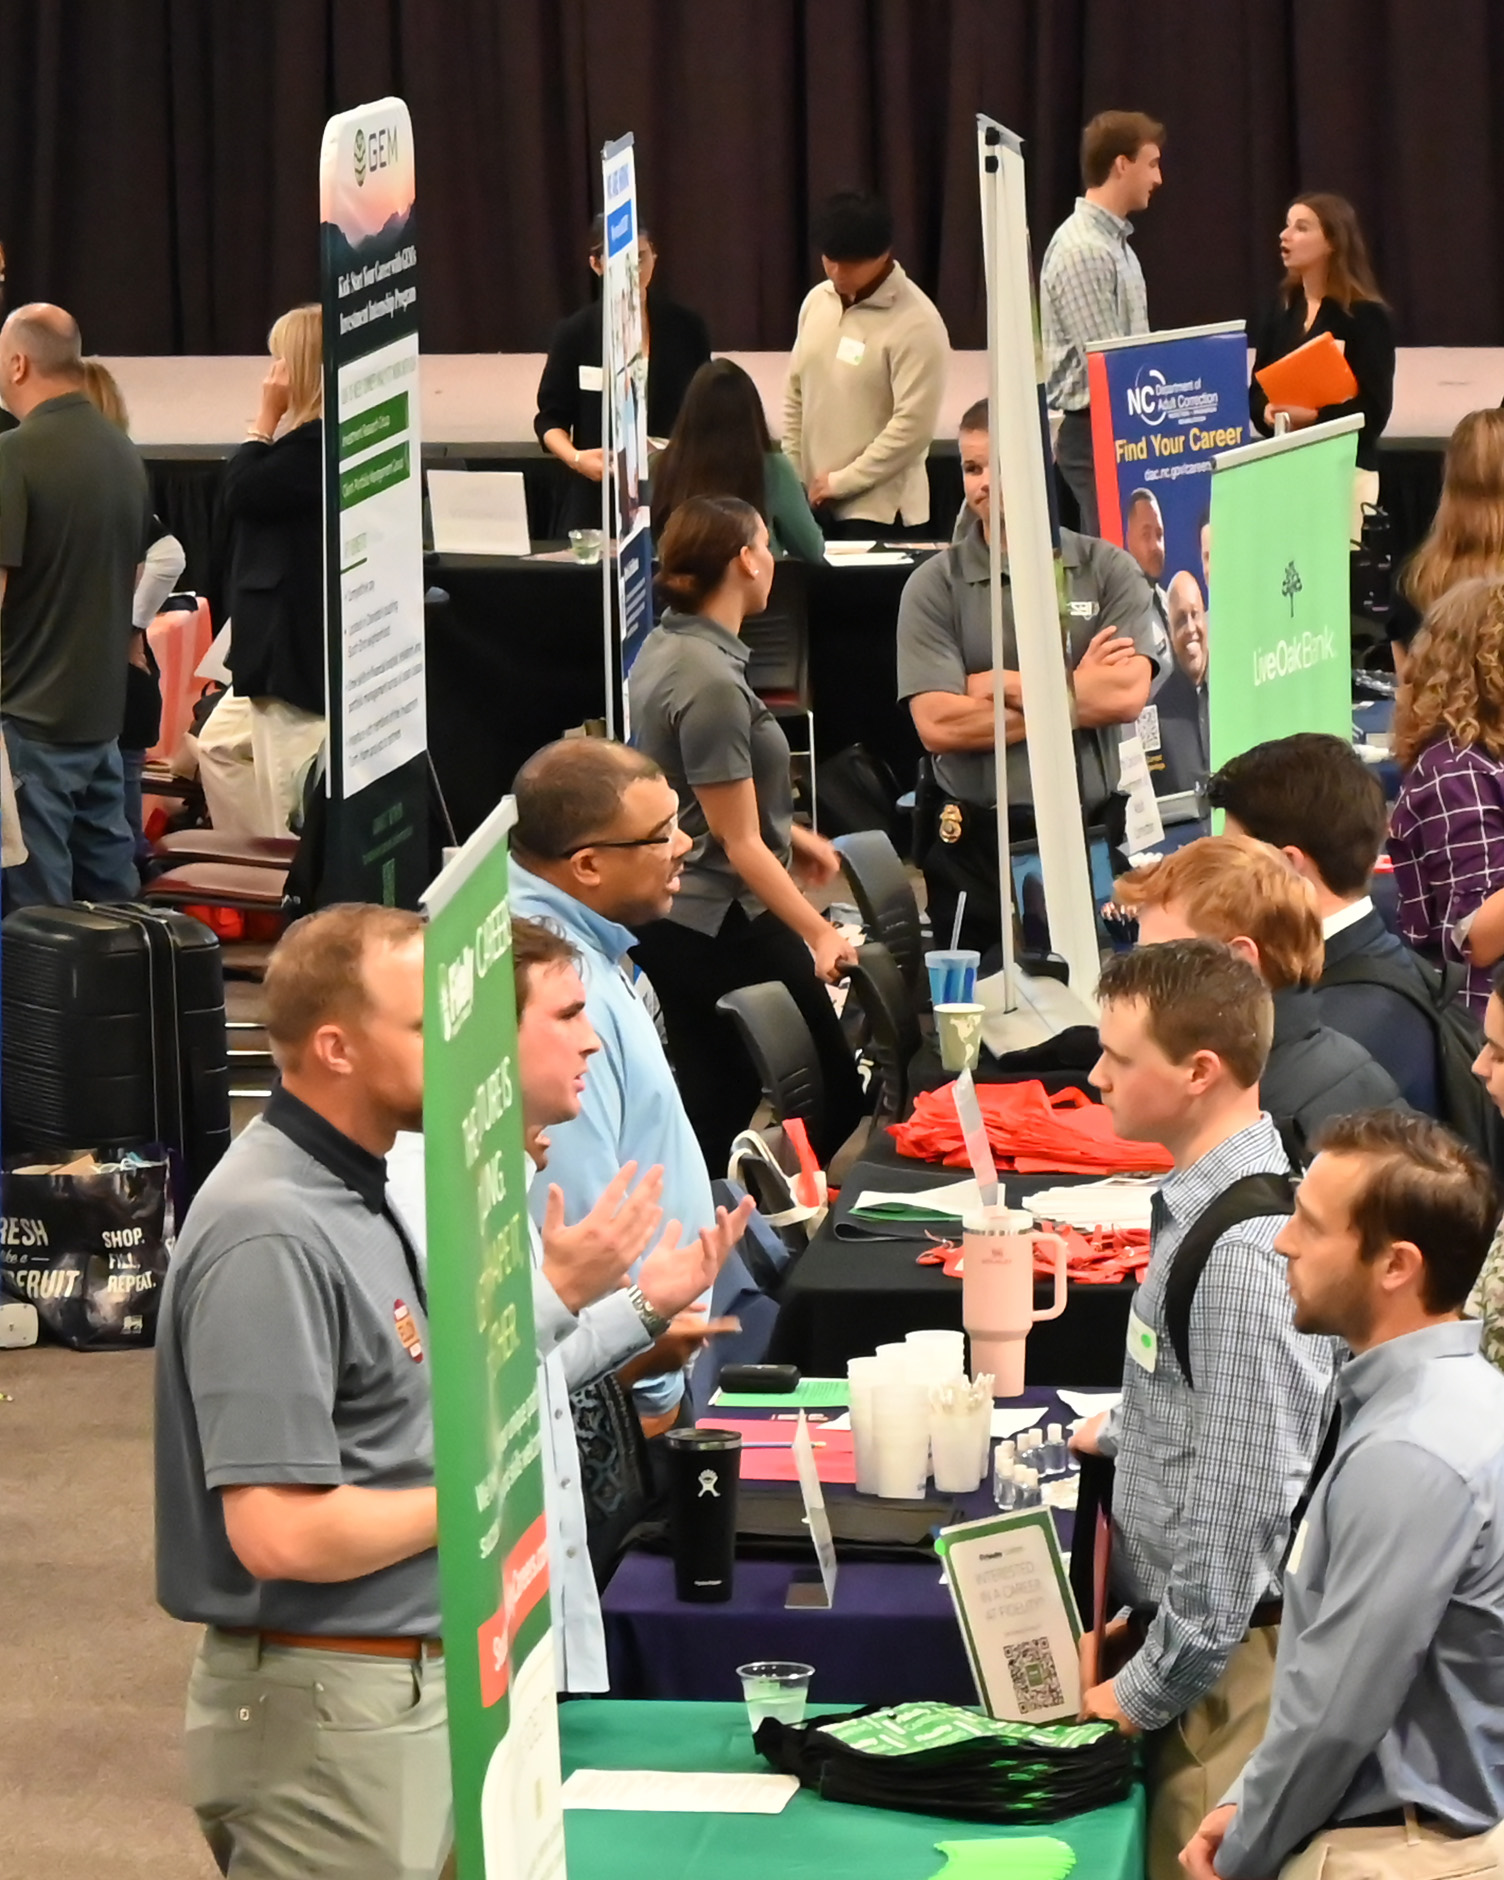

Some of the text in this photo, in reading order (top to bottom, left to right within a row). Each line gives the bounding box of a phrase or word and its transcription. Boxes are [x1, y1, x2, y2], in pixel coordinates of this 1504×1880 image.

[368, 125, 399, 173] GEM
[1127, 385, 1155, 416] NC
[1177, 392, 1219, 409] Correction
[1115, 427, 1244, 464] Find Your Career
[102, 1227, 145, 1248] SHOP.
[107, 1270, 157, 1293] REPEAT.
